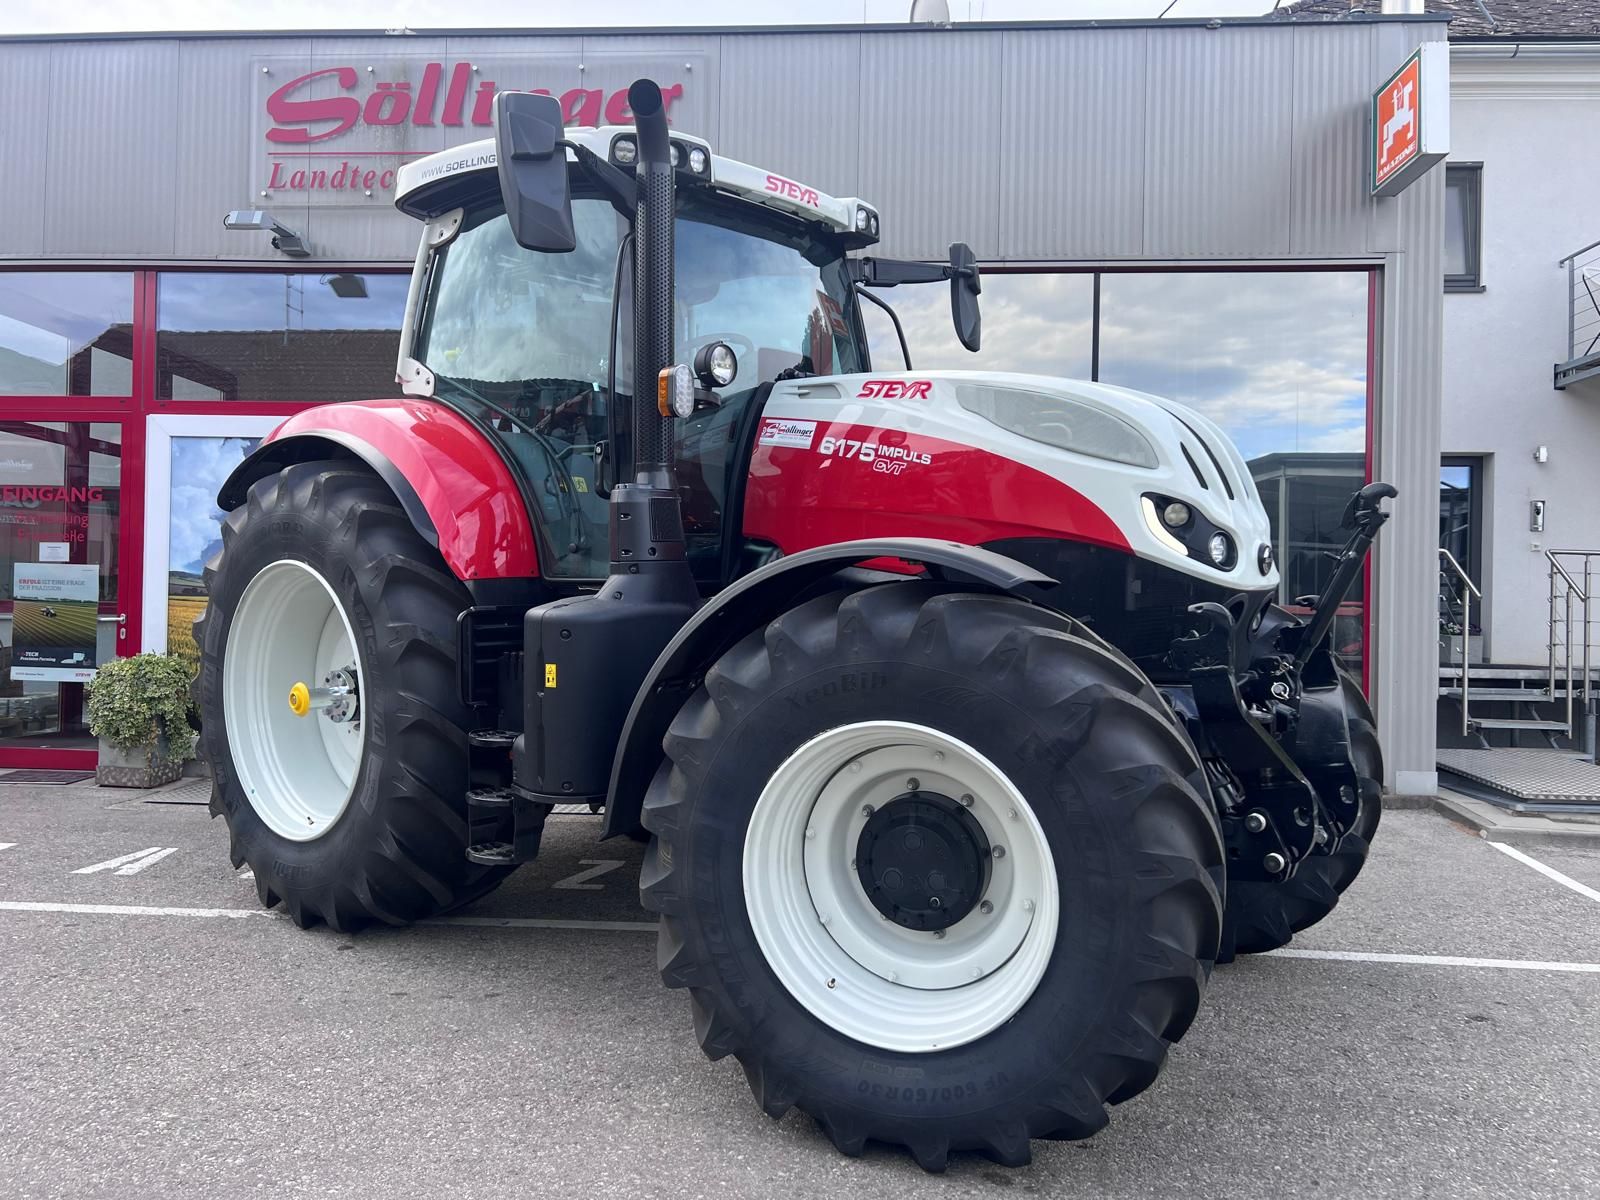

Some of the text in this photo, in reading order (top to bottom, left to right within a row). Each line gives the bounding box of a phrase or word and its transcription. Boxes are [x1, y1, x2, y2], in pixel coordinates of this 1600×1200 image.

[265, 62, 684, 144] Sölliger
[268, 161, 409, 189] Landtec
[421, 154, 498, 179] WWW.SOELLING
[765, 175, 819, 208] STEYR
[856, 380, 932, 400] STEYR
[820, 436, 932, 465] 6175 IMPULS
[872, 458, 906, 475] CVT
[2, 486, 103, 502] EINGANG
